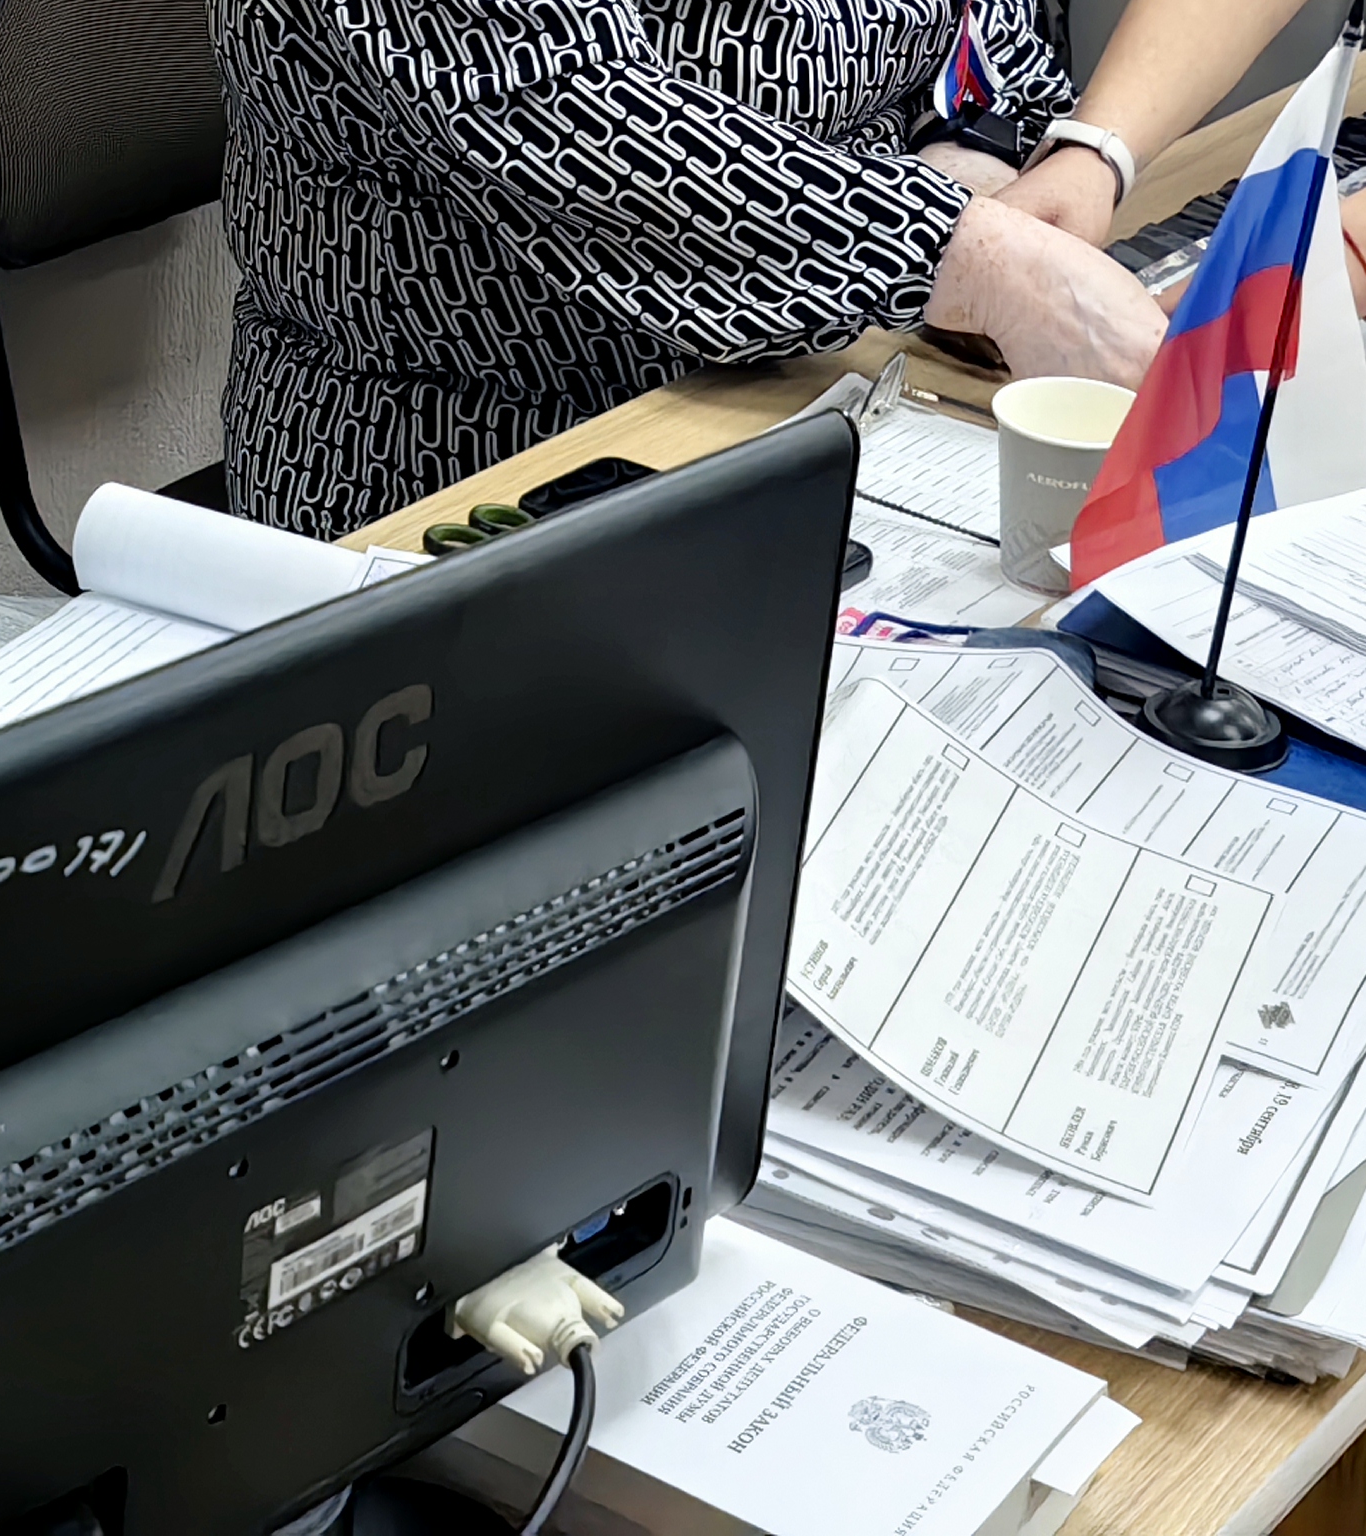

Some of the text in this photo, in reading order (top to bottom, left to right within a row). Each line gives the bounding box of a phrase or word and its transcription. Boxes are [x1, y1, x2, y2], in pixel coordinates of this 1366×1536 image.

[1232, 1102, 1281, 1158] сентября
[1270, 1090, 1292, 1109] 19
[640, 1280, 775, 1405] РОССИЙСКОЙ ФЕДЕРАЦИИ
[658, 1285, 791, 1414] ФЕДЕРАЛЬНОГО СОБРАНИЯ
[675, 1295, 809, 1422] ГОСУДАРСТВЕННОЙ ДУМЫ
[701, 1305, 820, 1422] О ВЫБОРАХ ДЕПУТАТОВ
[727, 1314, 868, 1453] ФЕДЕРАЛЬНЫЙ ЗАКОН
[894, 1386, 1034, 1536] РОССИЙСКАЯ ФЕДЕРАЦИЯ
